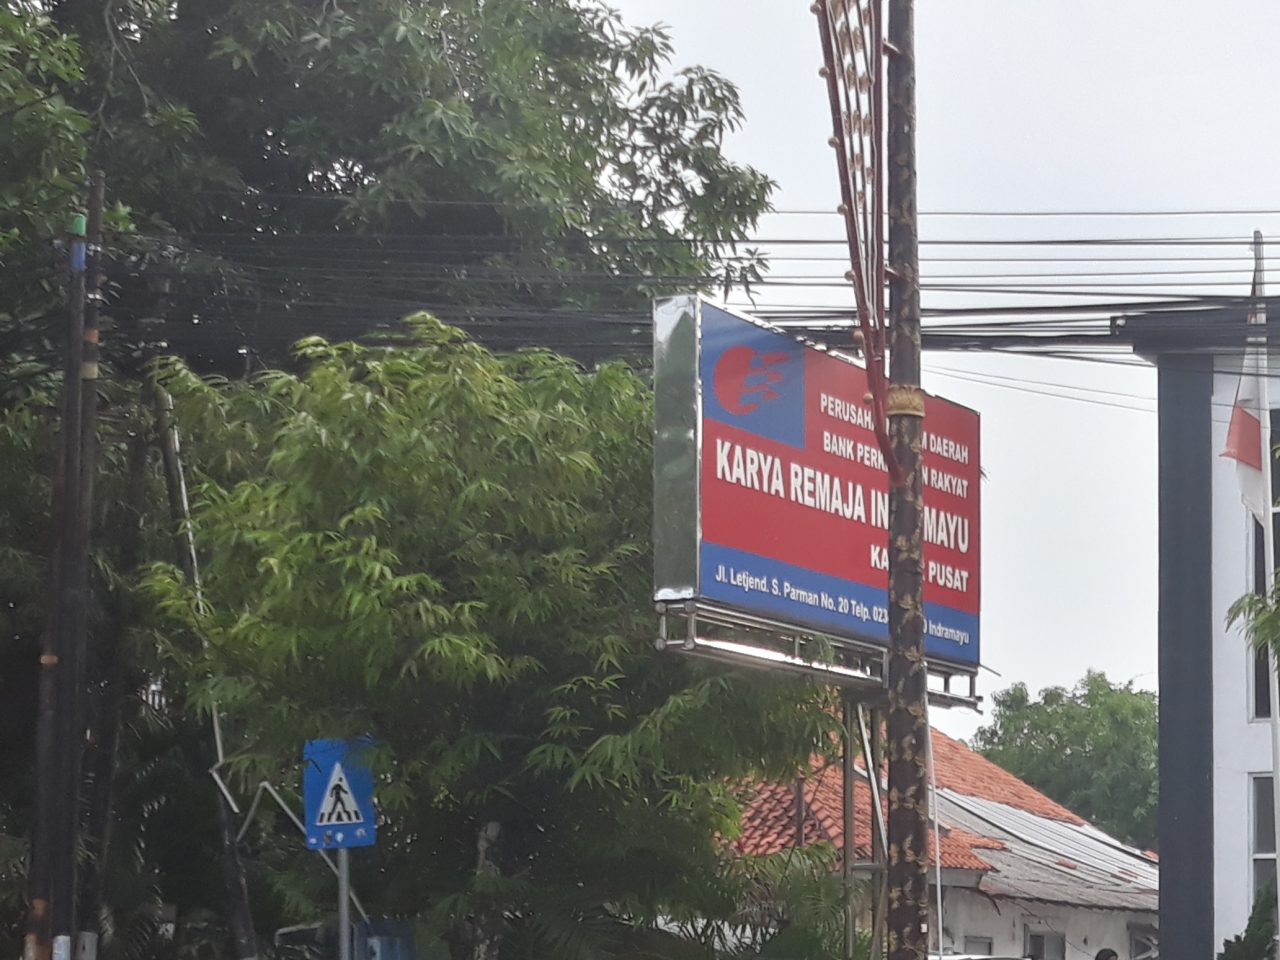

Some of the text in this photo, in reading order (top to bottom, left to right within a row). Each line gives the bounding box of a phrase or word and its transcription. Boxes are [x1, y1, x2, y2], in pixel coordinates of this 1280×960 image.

[820, 392, 889, 437] PERUSAH
[929, 433, 969, 465] DAERAH
[823, 430, 969, 499] BANK RAKYAT
[716, 438, 786, 499] KARYA
[790, 462, 867, 524] REMAJA
[870, 489, 970, 554] INMAYU
[715, 564, 728, 583] Jl.
[730, 567, 770, 592] Letjend.
[771, 578, 782, 596] S.
[783, 581, 819, 606] Parman
[820, 592, 837, 612] No.
[838, 596, 849, 614] 20
[851, 599, 871, 622] Telp.
[929, 621, 969, 646] Indramayu
[928, 561, 969, 592] PUSAT
